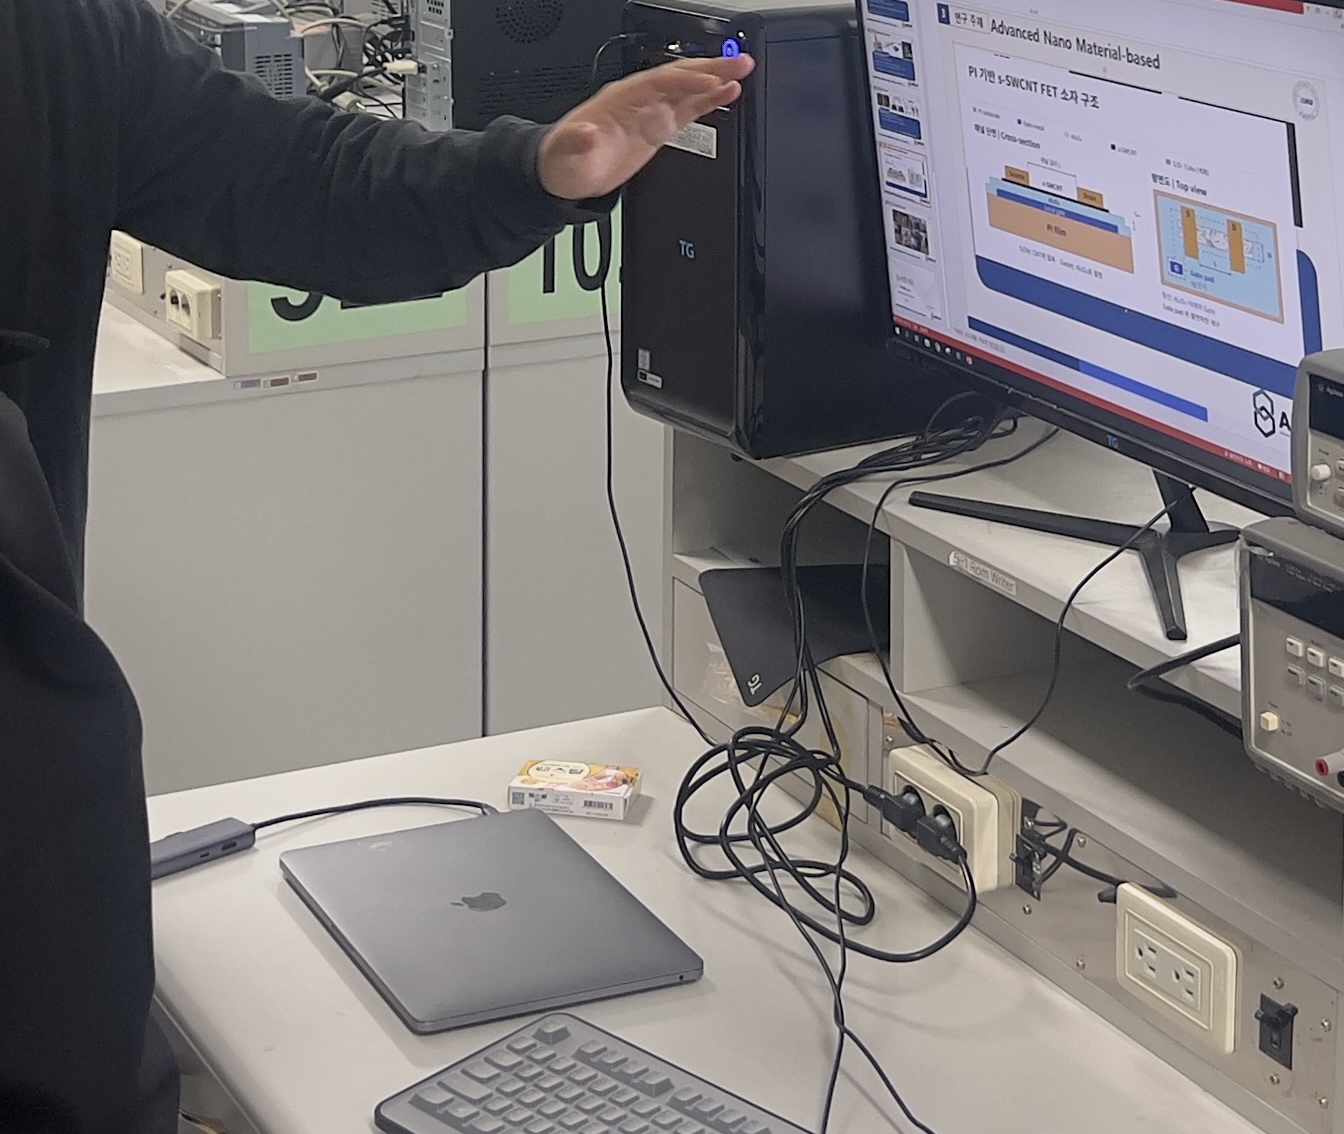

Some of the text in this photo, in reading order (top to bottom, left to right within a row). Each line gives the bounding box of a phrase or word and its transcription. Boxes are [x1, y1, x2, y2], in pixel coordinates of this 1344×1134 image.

[991, 19, 1161, 70] Advanced Nano Material-based
[968, 65, 1100, 109] PI 기반 s-SWCNT FET 소자 구조
[1176, 180, 1189, 193] Top
[678, 239, 696, 259] TG
[1107, 434, 1119, 449] TG
[970, 561, 989, 579] Rom
[990, 569, 1014, 592] Writer
[747, 674, 762, 695] TG
